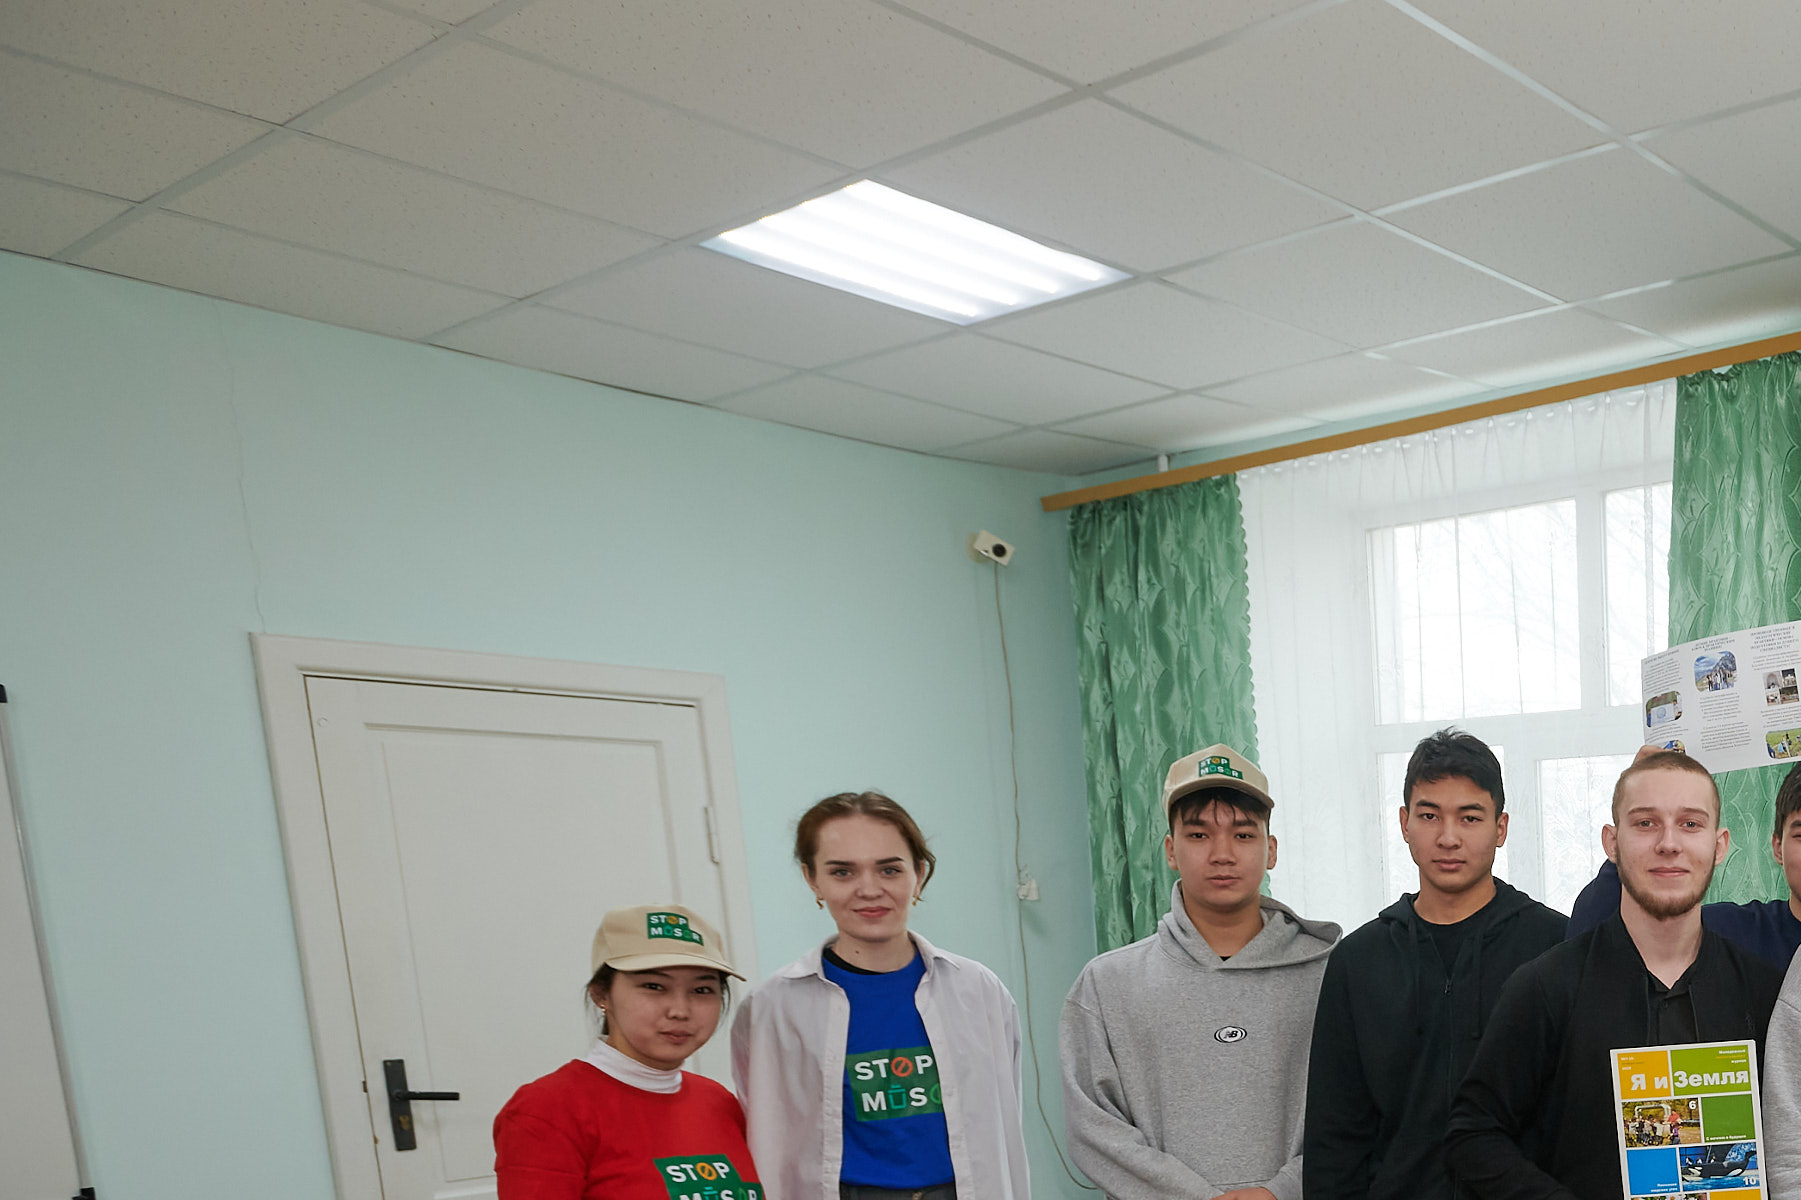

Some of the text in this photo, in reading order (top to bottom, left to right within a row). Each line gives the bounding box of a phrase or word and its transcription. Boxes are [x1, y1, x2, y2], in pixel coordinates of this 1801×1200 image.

[650, 915, 687, 925] STOP
[854, 1055, 933, 1080] STOP
[1631, 1070, 1749, 1091] Я и Земля
[1689, 1100, 1697, 1110] 6
[666, 1162, 730, 1182] STOP
[1743, 1177, 1757, 1185] 10
